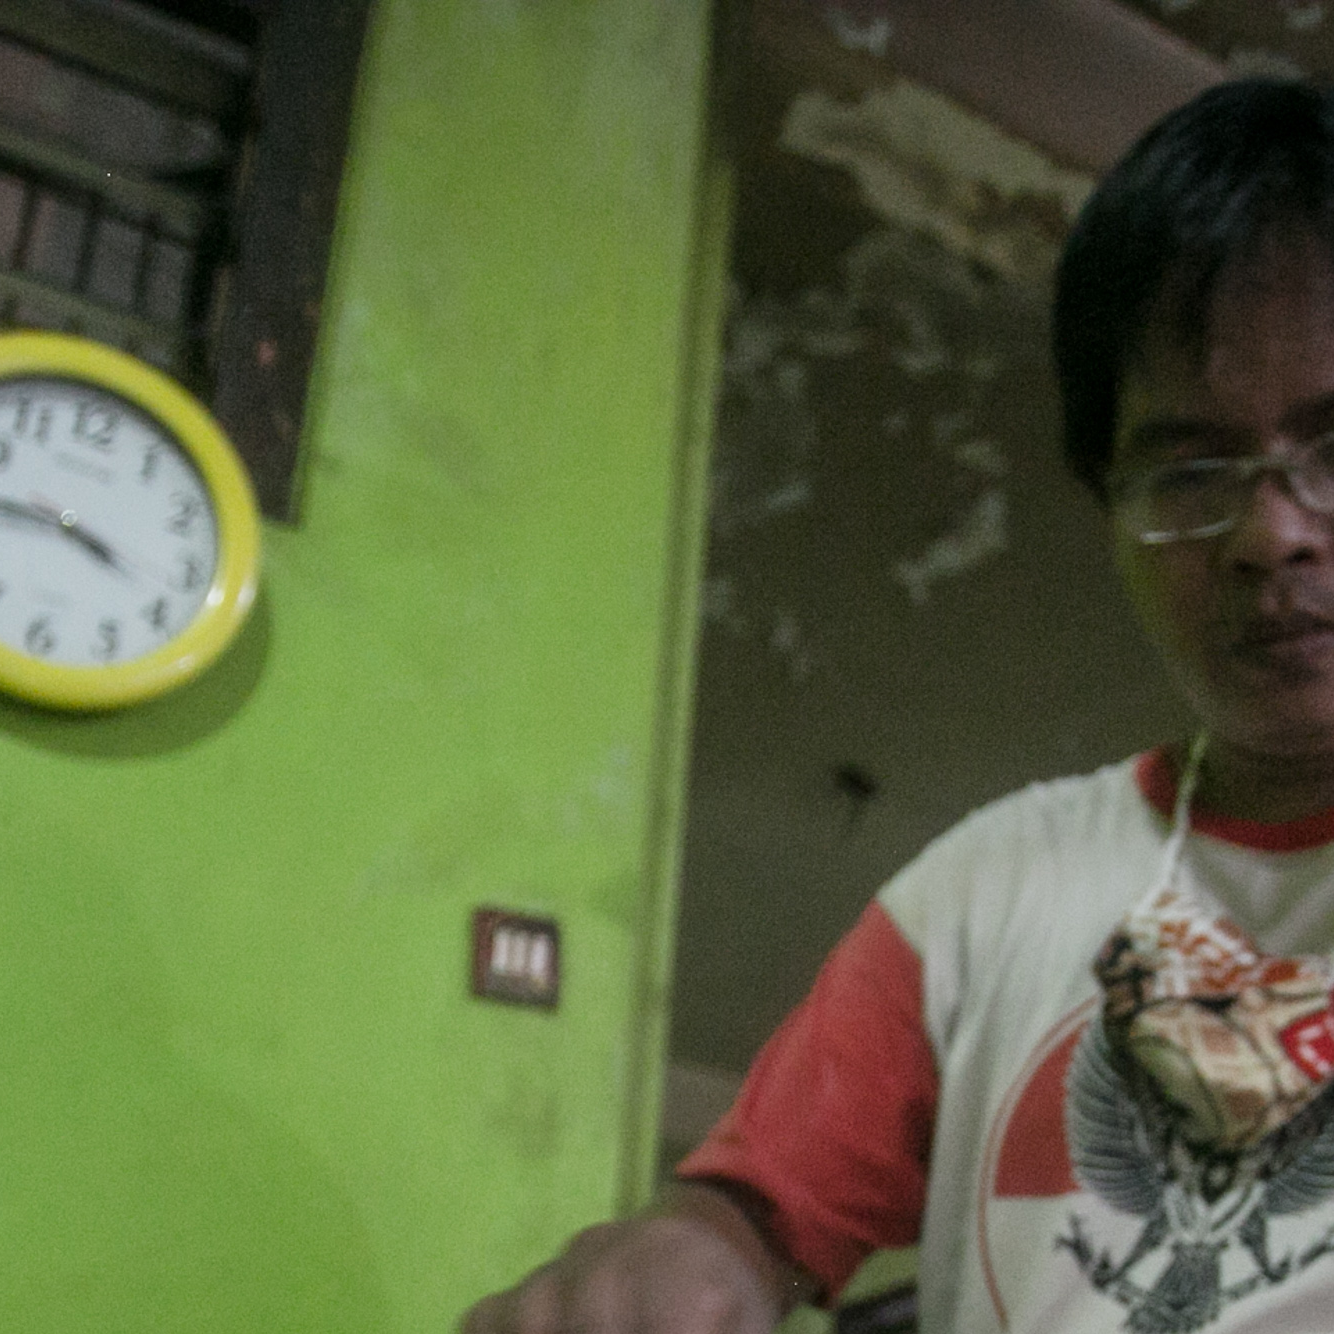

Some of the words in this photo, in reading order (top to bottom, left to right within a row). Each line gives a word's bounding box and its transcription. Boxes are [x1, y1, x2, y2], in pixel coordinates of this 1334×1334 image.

[12, 396, 54, 445] 11
[69, 402, 120, 451] 12
[23, 614, 56, 656] 6
